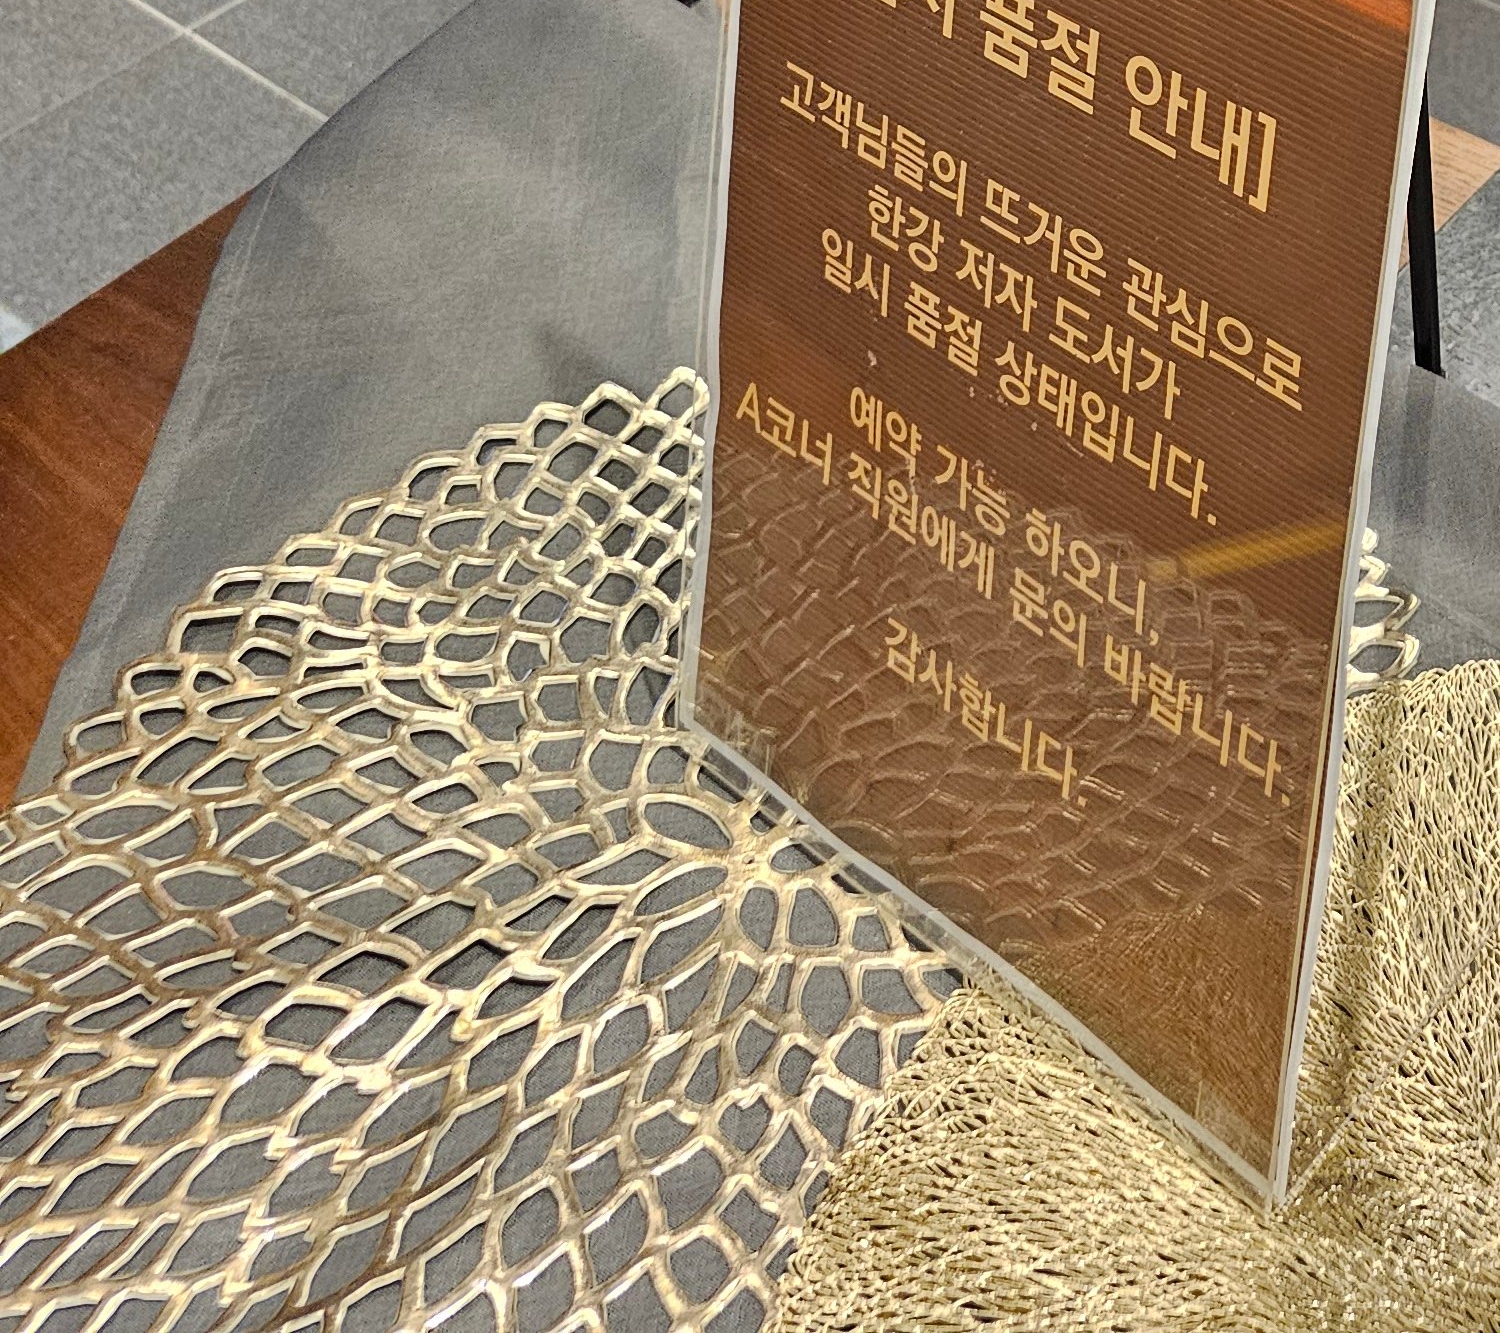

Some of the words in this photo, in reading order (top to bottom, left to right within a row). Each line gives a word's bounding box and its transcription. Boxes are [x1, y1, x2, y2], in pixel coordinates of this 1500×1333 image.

[779, 61, 967, 217] 고객님들의
[979, 177, 1107, 298] 뜨거운
[1122, 258, 1304, 413] 관심으로
[1123, 54, 1278, 214] 안내]
[820, 227, 891, 319] 일시
[903, 277, 983, 377] 품절
[995, 338, 1218, 526] 상태입니다.
[868, 185, 945, 273] 한강
[956, 240, 1040, 332] 저자
[1050, 294, 1183, 421] 도서가
[736, 382, 836, 486] A코너
[847, 456, 996, 600] 직원에게
[1007, 576, 1087, 670] 문의
[1103, 633, 1293, 807] 바랍니다.
[848, 386, 923, 479] 예약
[934, 443, 1009, 537] 가능
[1023, 507, 1161, 643] 하오니,
[882, 618, 1090, 808] 감사합니다.
